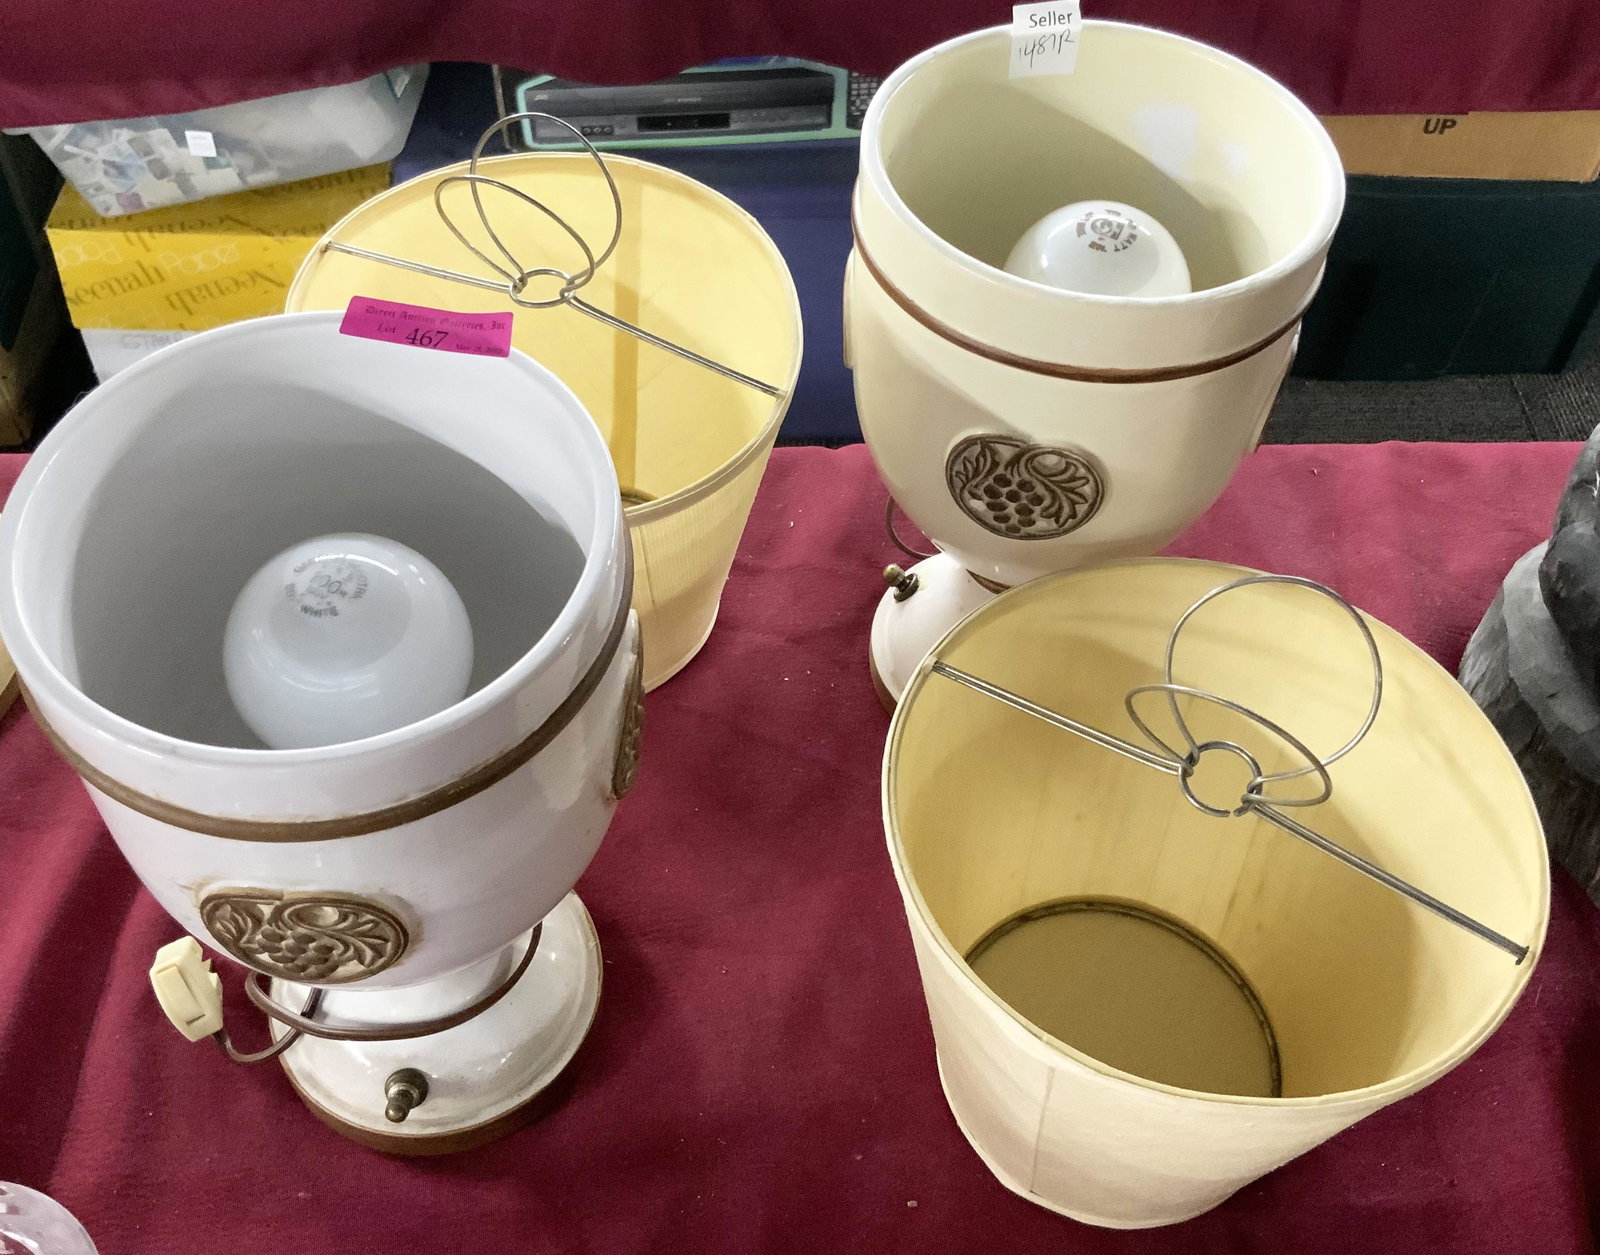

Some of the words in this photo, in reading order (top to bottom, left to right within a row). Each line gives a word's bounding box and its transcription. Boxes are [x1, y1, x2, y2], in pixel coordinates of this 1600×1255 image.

[1029, 10, 1072, 28] Seller
[1423, 117, 1457, 135] UP
[63, 258, 166, 307] eenah
[377, 323, 397, 334] Lot
[405, 327, 449, 348] 467
